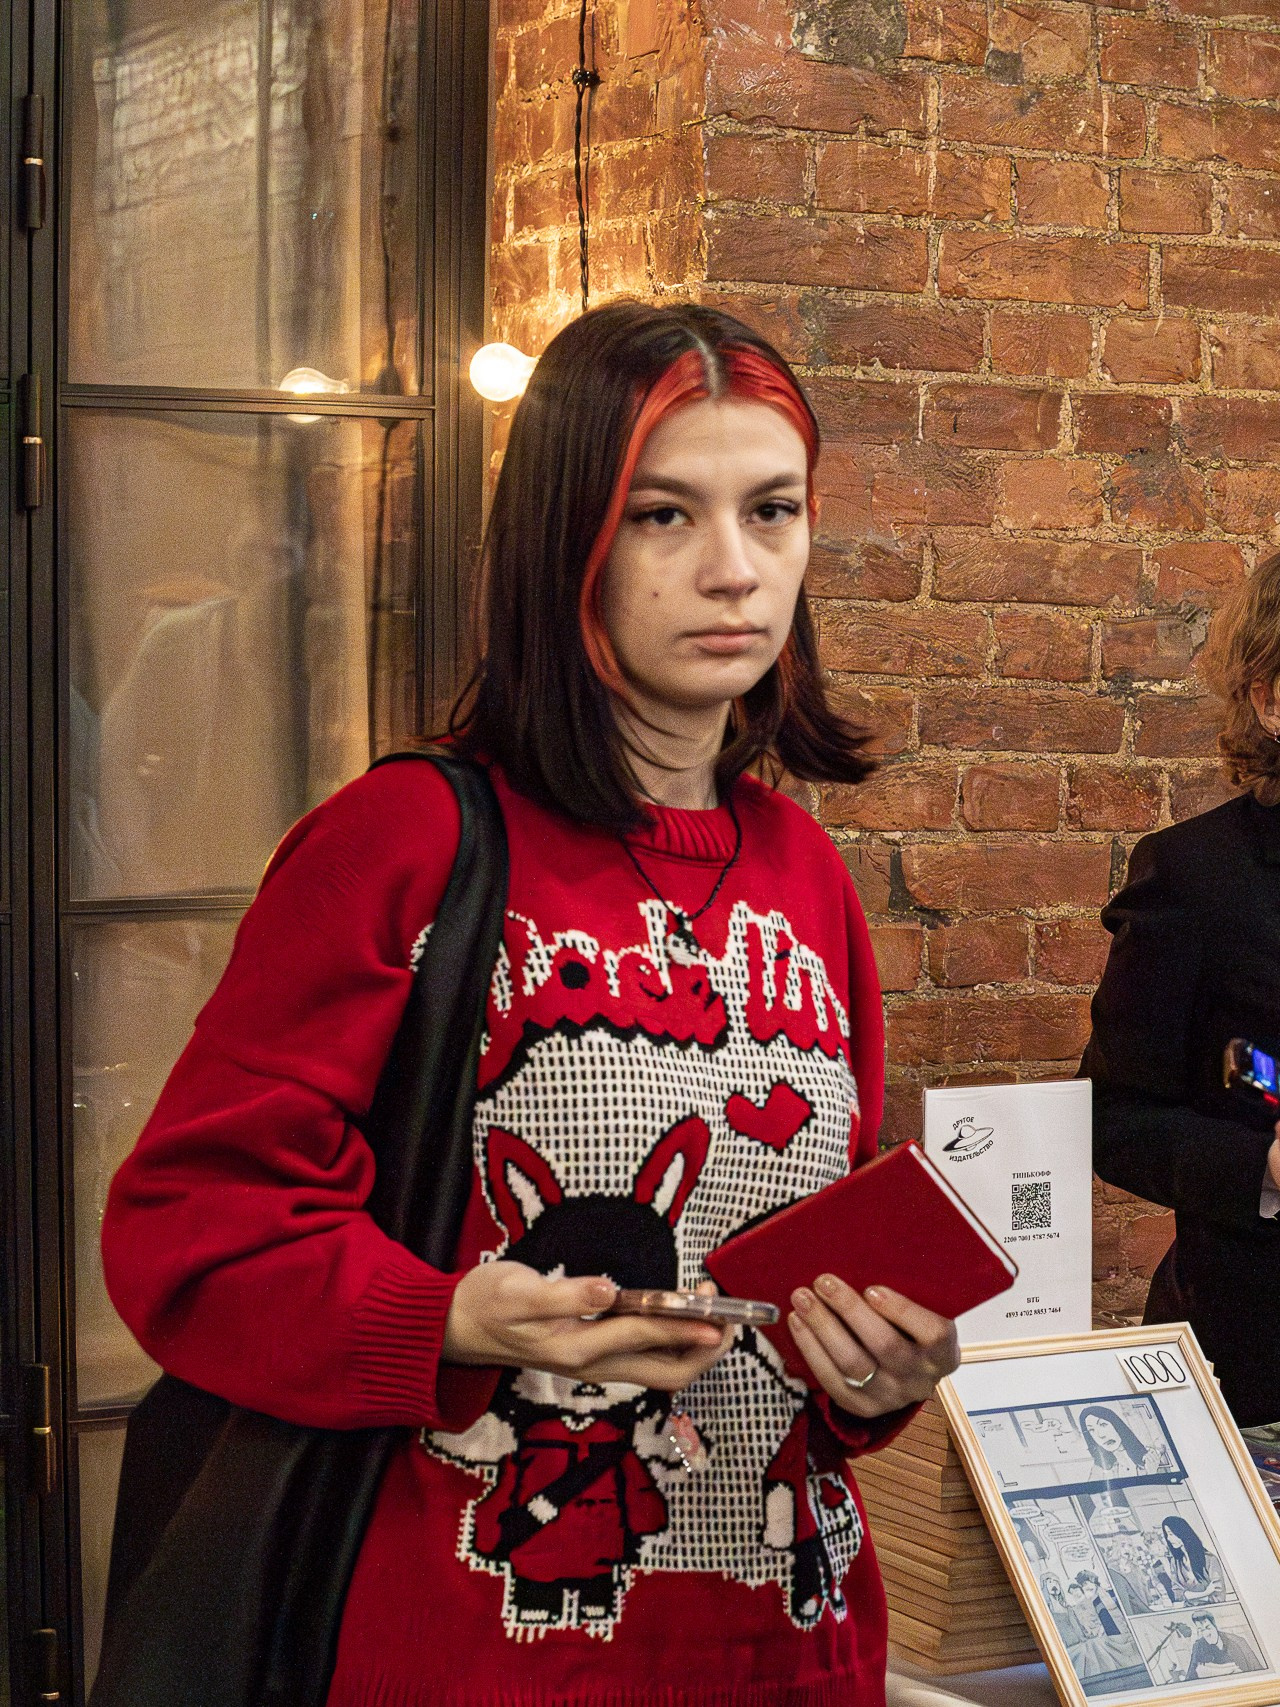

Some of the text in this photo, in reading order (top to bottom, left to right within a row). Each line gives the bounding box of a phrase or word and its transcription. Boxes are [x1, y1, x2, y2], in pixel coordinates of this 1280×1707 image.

[952, 1116, 975, 1131] ДРУГОЕ
[949, 1139, 994, 1163] ИЗДАТЕЛЬСТВО
[1012, 1170, 1052, 1180] ТИНЬКОФФ
[1123, 1349, 1186, 1386] 1000
